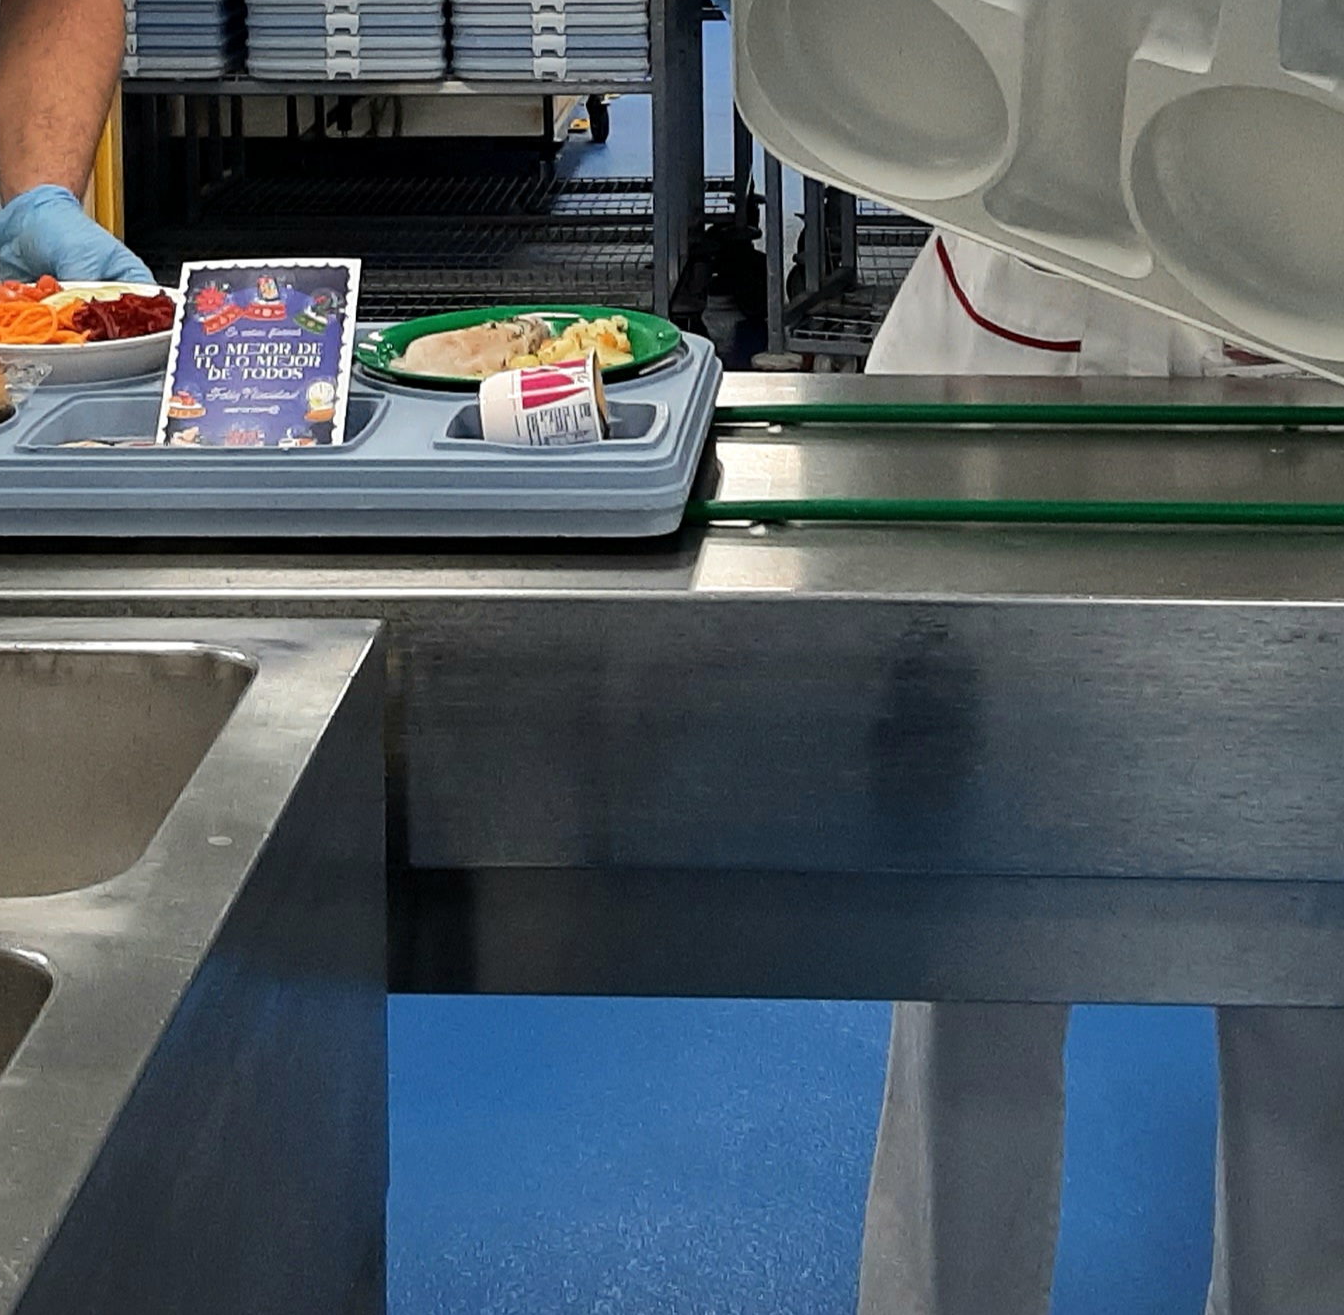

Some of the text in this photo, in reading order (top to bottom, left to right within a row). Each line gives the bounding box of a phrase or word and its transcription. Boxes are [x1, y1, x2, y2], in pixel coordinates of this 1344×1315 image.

[194, 342, 323, 358] LO MEJOR DE
[225, 355, 250, 368] LO
[256, 355, 321, 368] MEJOR
[207, 367, 305, 381] DE TODOS
